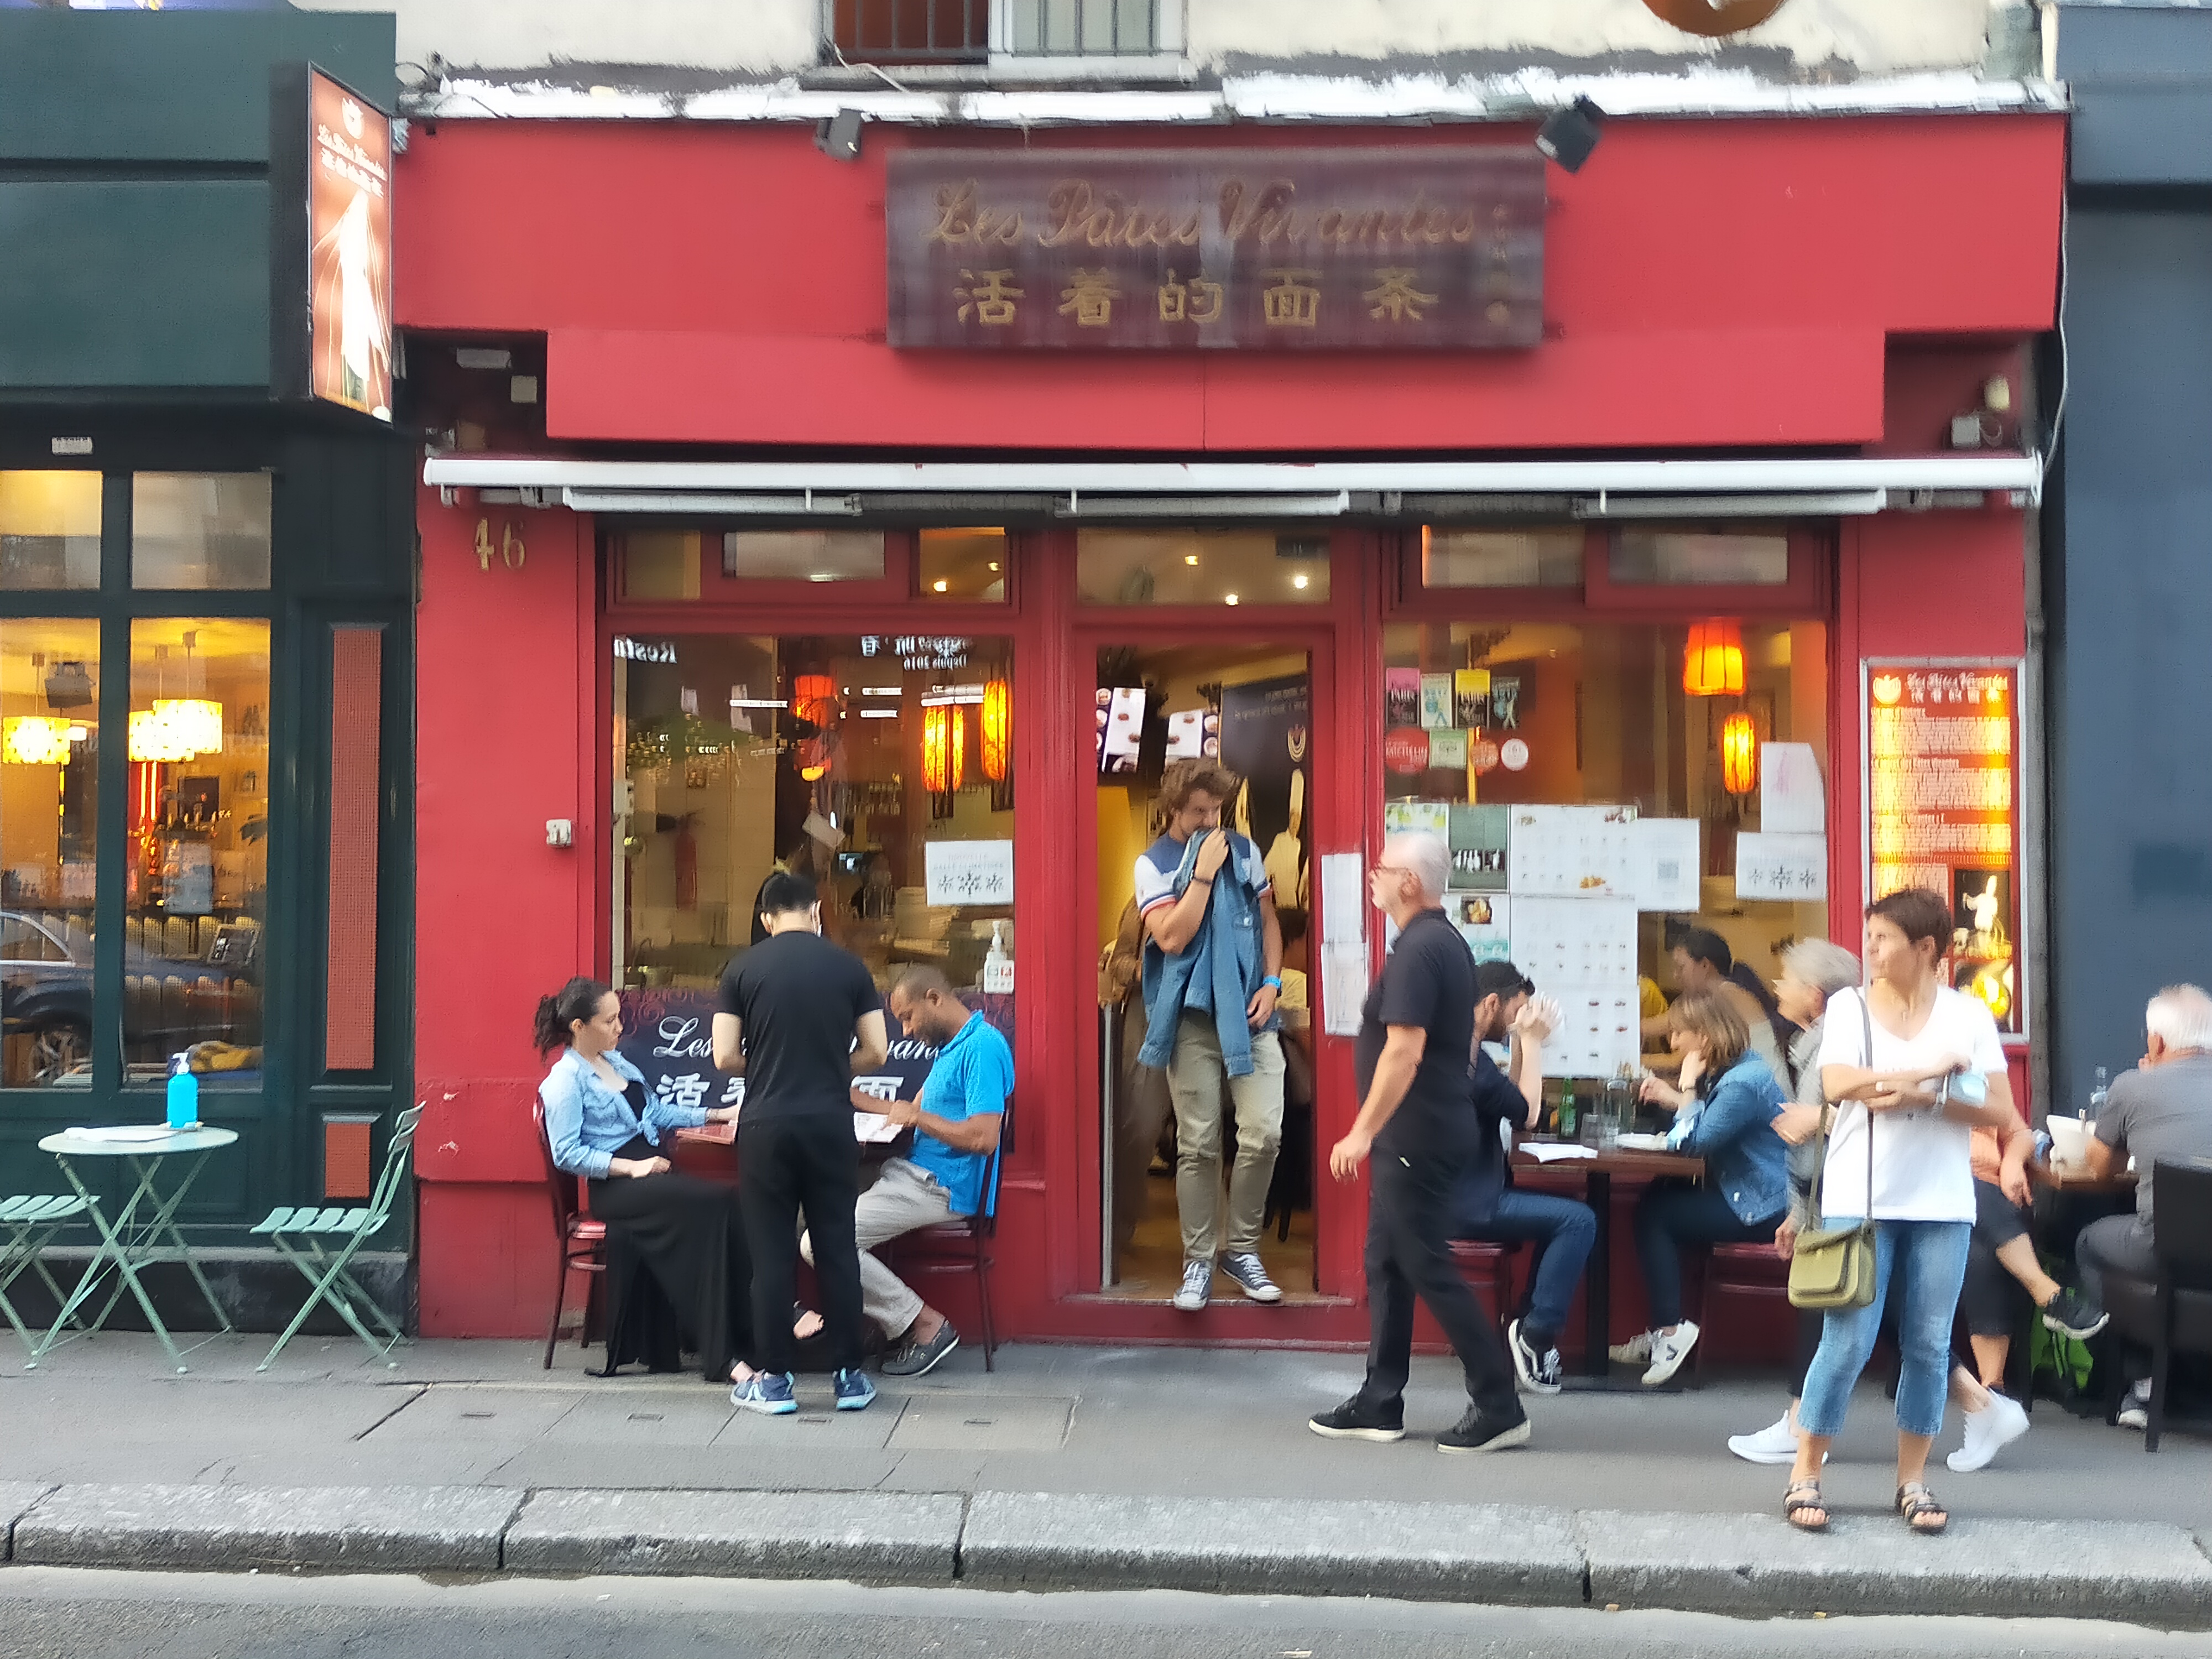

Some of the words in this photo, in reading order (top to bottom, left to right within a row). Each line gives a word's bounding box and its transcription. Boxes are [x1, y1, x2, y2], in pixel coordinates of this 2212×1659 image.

[921, 176, 1024, 244] Les
[1218, 175, 1476, 244] Vivantes
[474, 517, 525, 571] 46
[653, 1015, 714, 1058] Les
